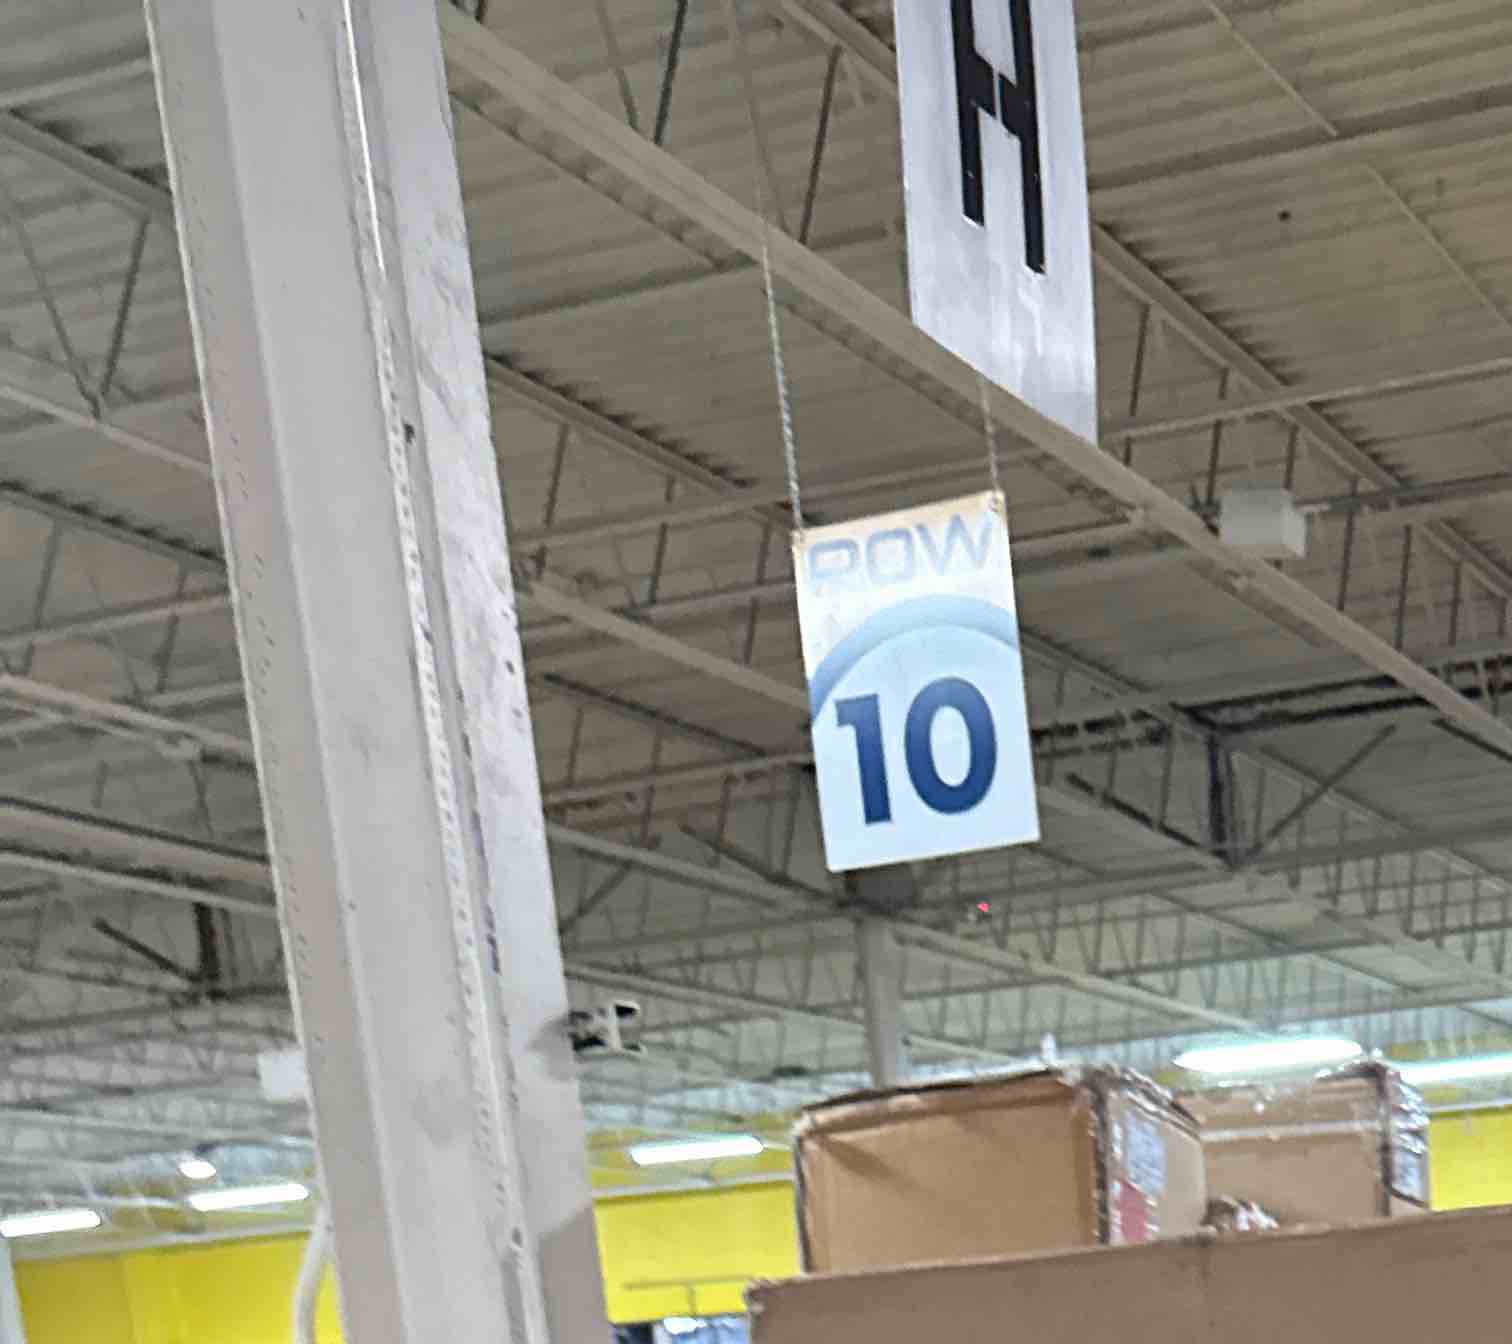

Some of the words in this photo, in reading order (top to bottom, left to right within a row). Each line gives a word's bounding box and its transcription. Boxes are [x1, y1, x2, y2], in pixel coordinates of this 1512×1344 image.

[951, 0, 1045, 274] H
[809, 512, 992, 589] ROW
[835, 677, 998, 825] 10
